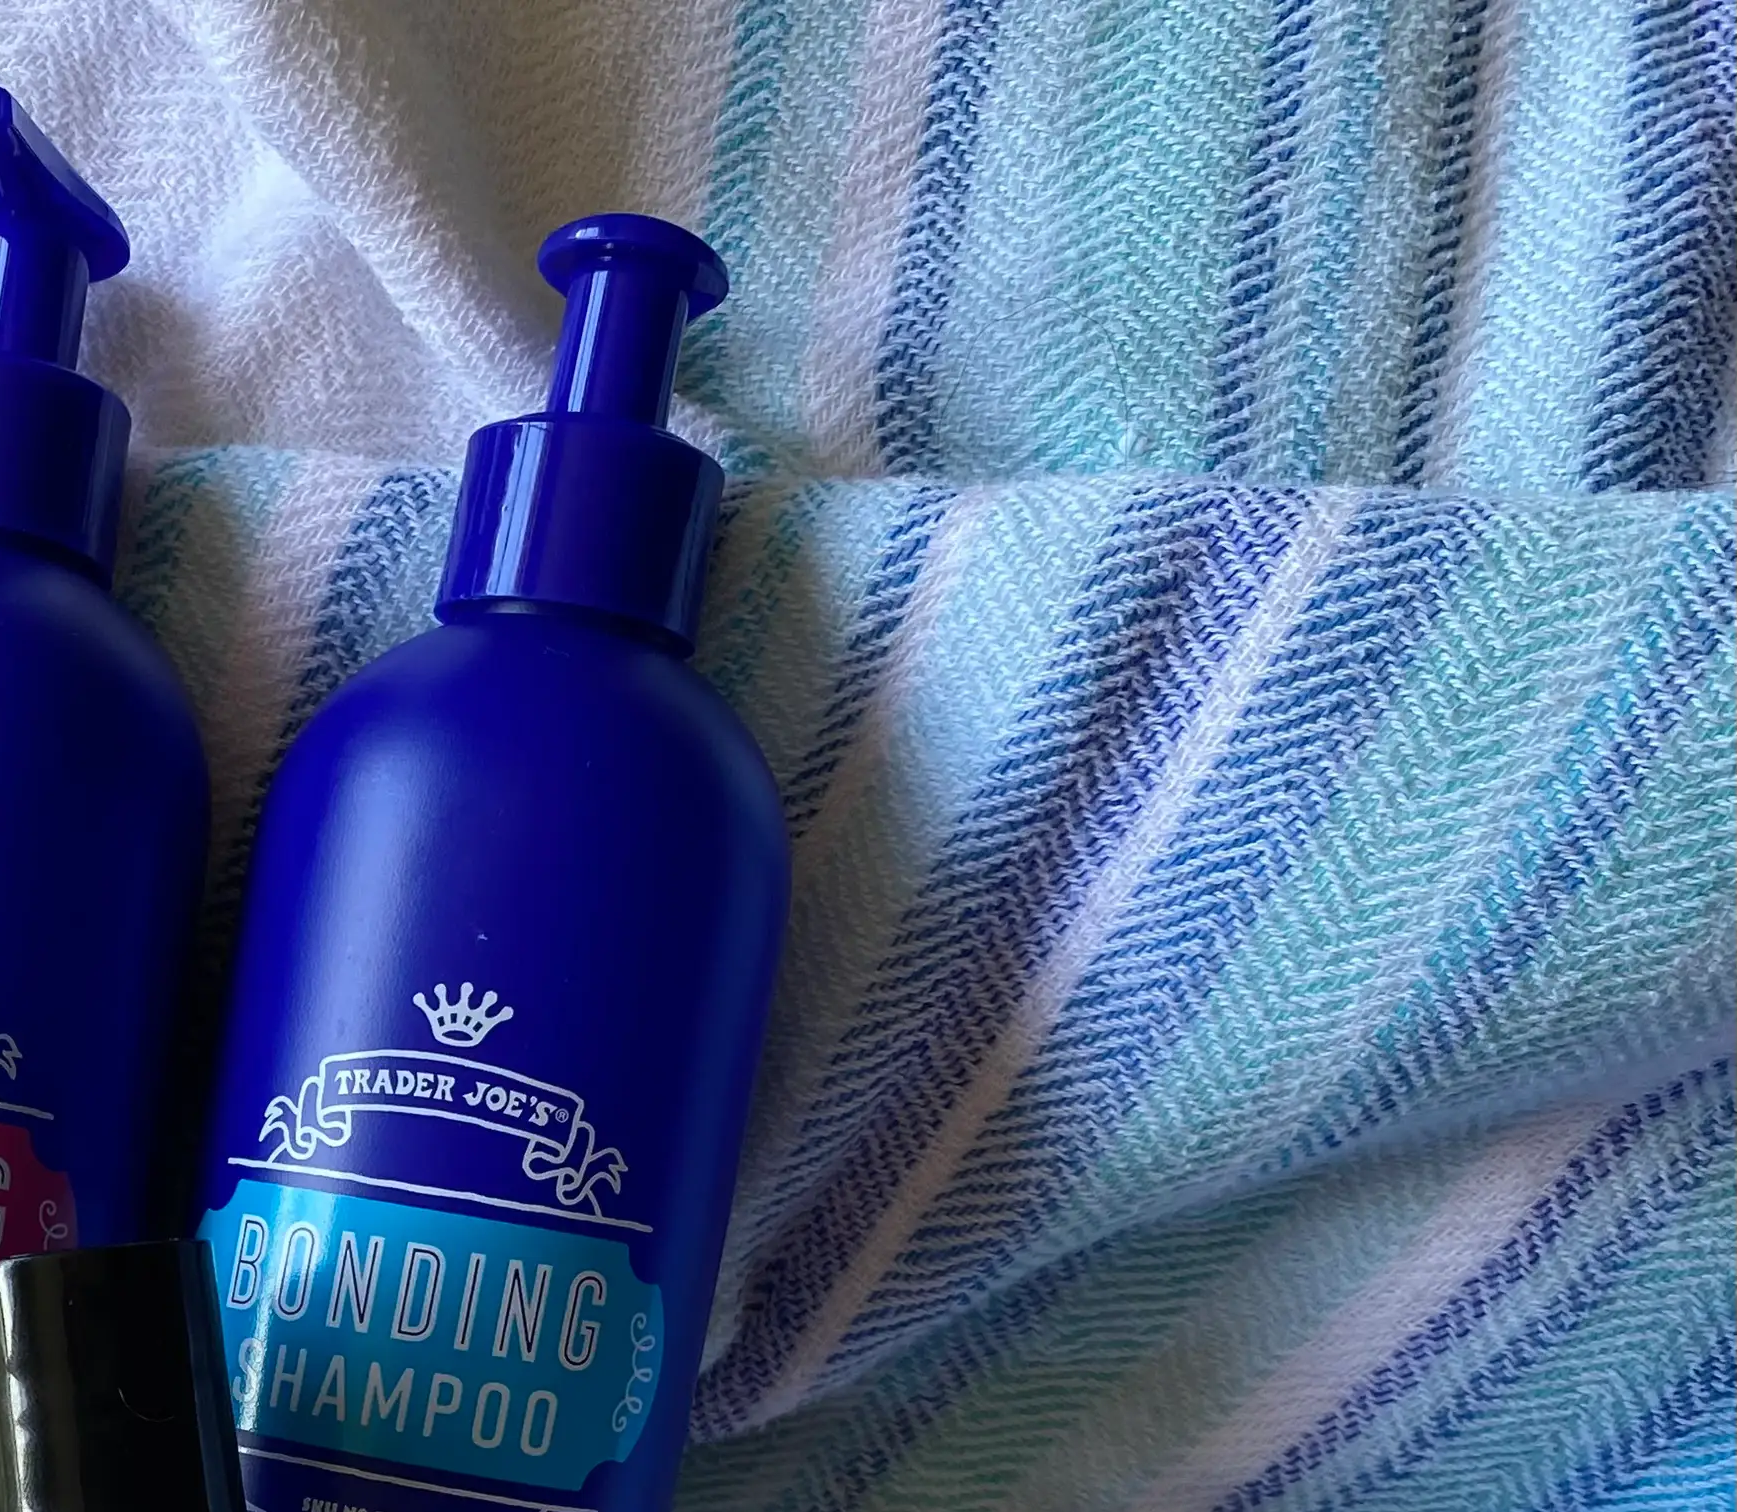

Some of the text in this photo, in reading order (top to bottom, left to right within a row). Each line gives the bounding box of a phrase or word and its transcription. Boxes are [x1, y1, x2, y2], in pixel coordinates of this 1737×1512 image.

[334, 1067, 455, 1102] TRADER
[225, 1213, 608, 1372] BONDING
[232, 1337, 560, 1458] SHAMPOO
